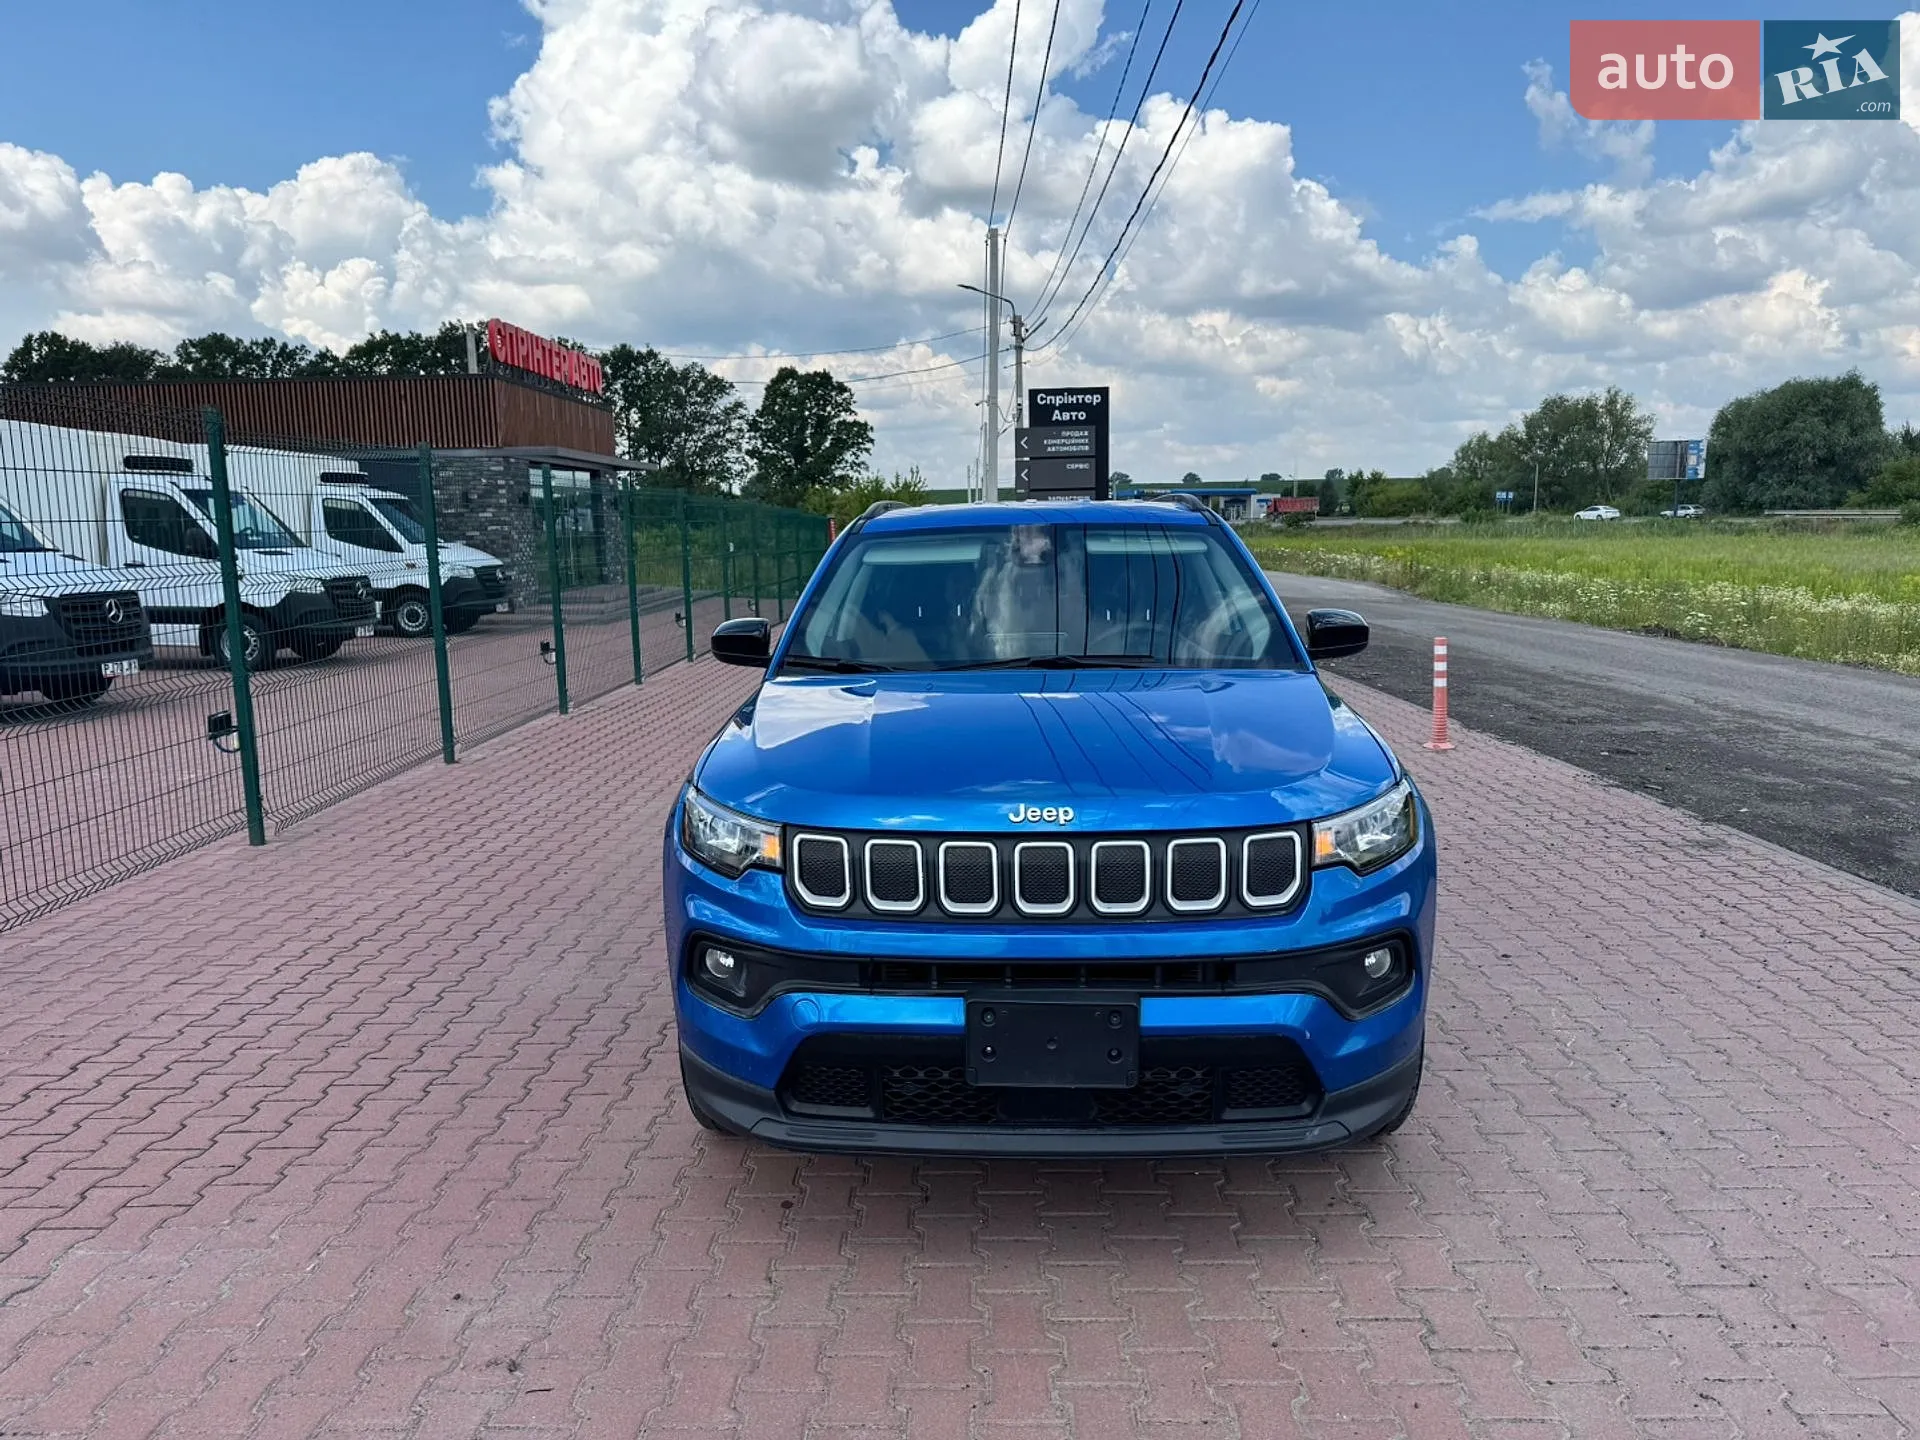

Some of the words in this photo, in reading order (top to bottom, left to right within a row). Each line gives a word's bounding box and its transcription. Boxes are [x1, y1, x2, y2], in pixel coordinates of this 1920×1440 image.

[567, 350, 603, 396] АВТО
[1037, 392, 1102, 407] Спрінтер
[1052, 409, 1087, 421] Авто
[1008, 803, 1075, 826] Jeep
